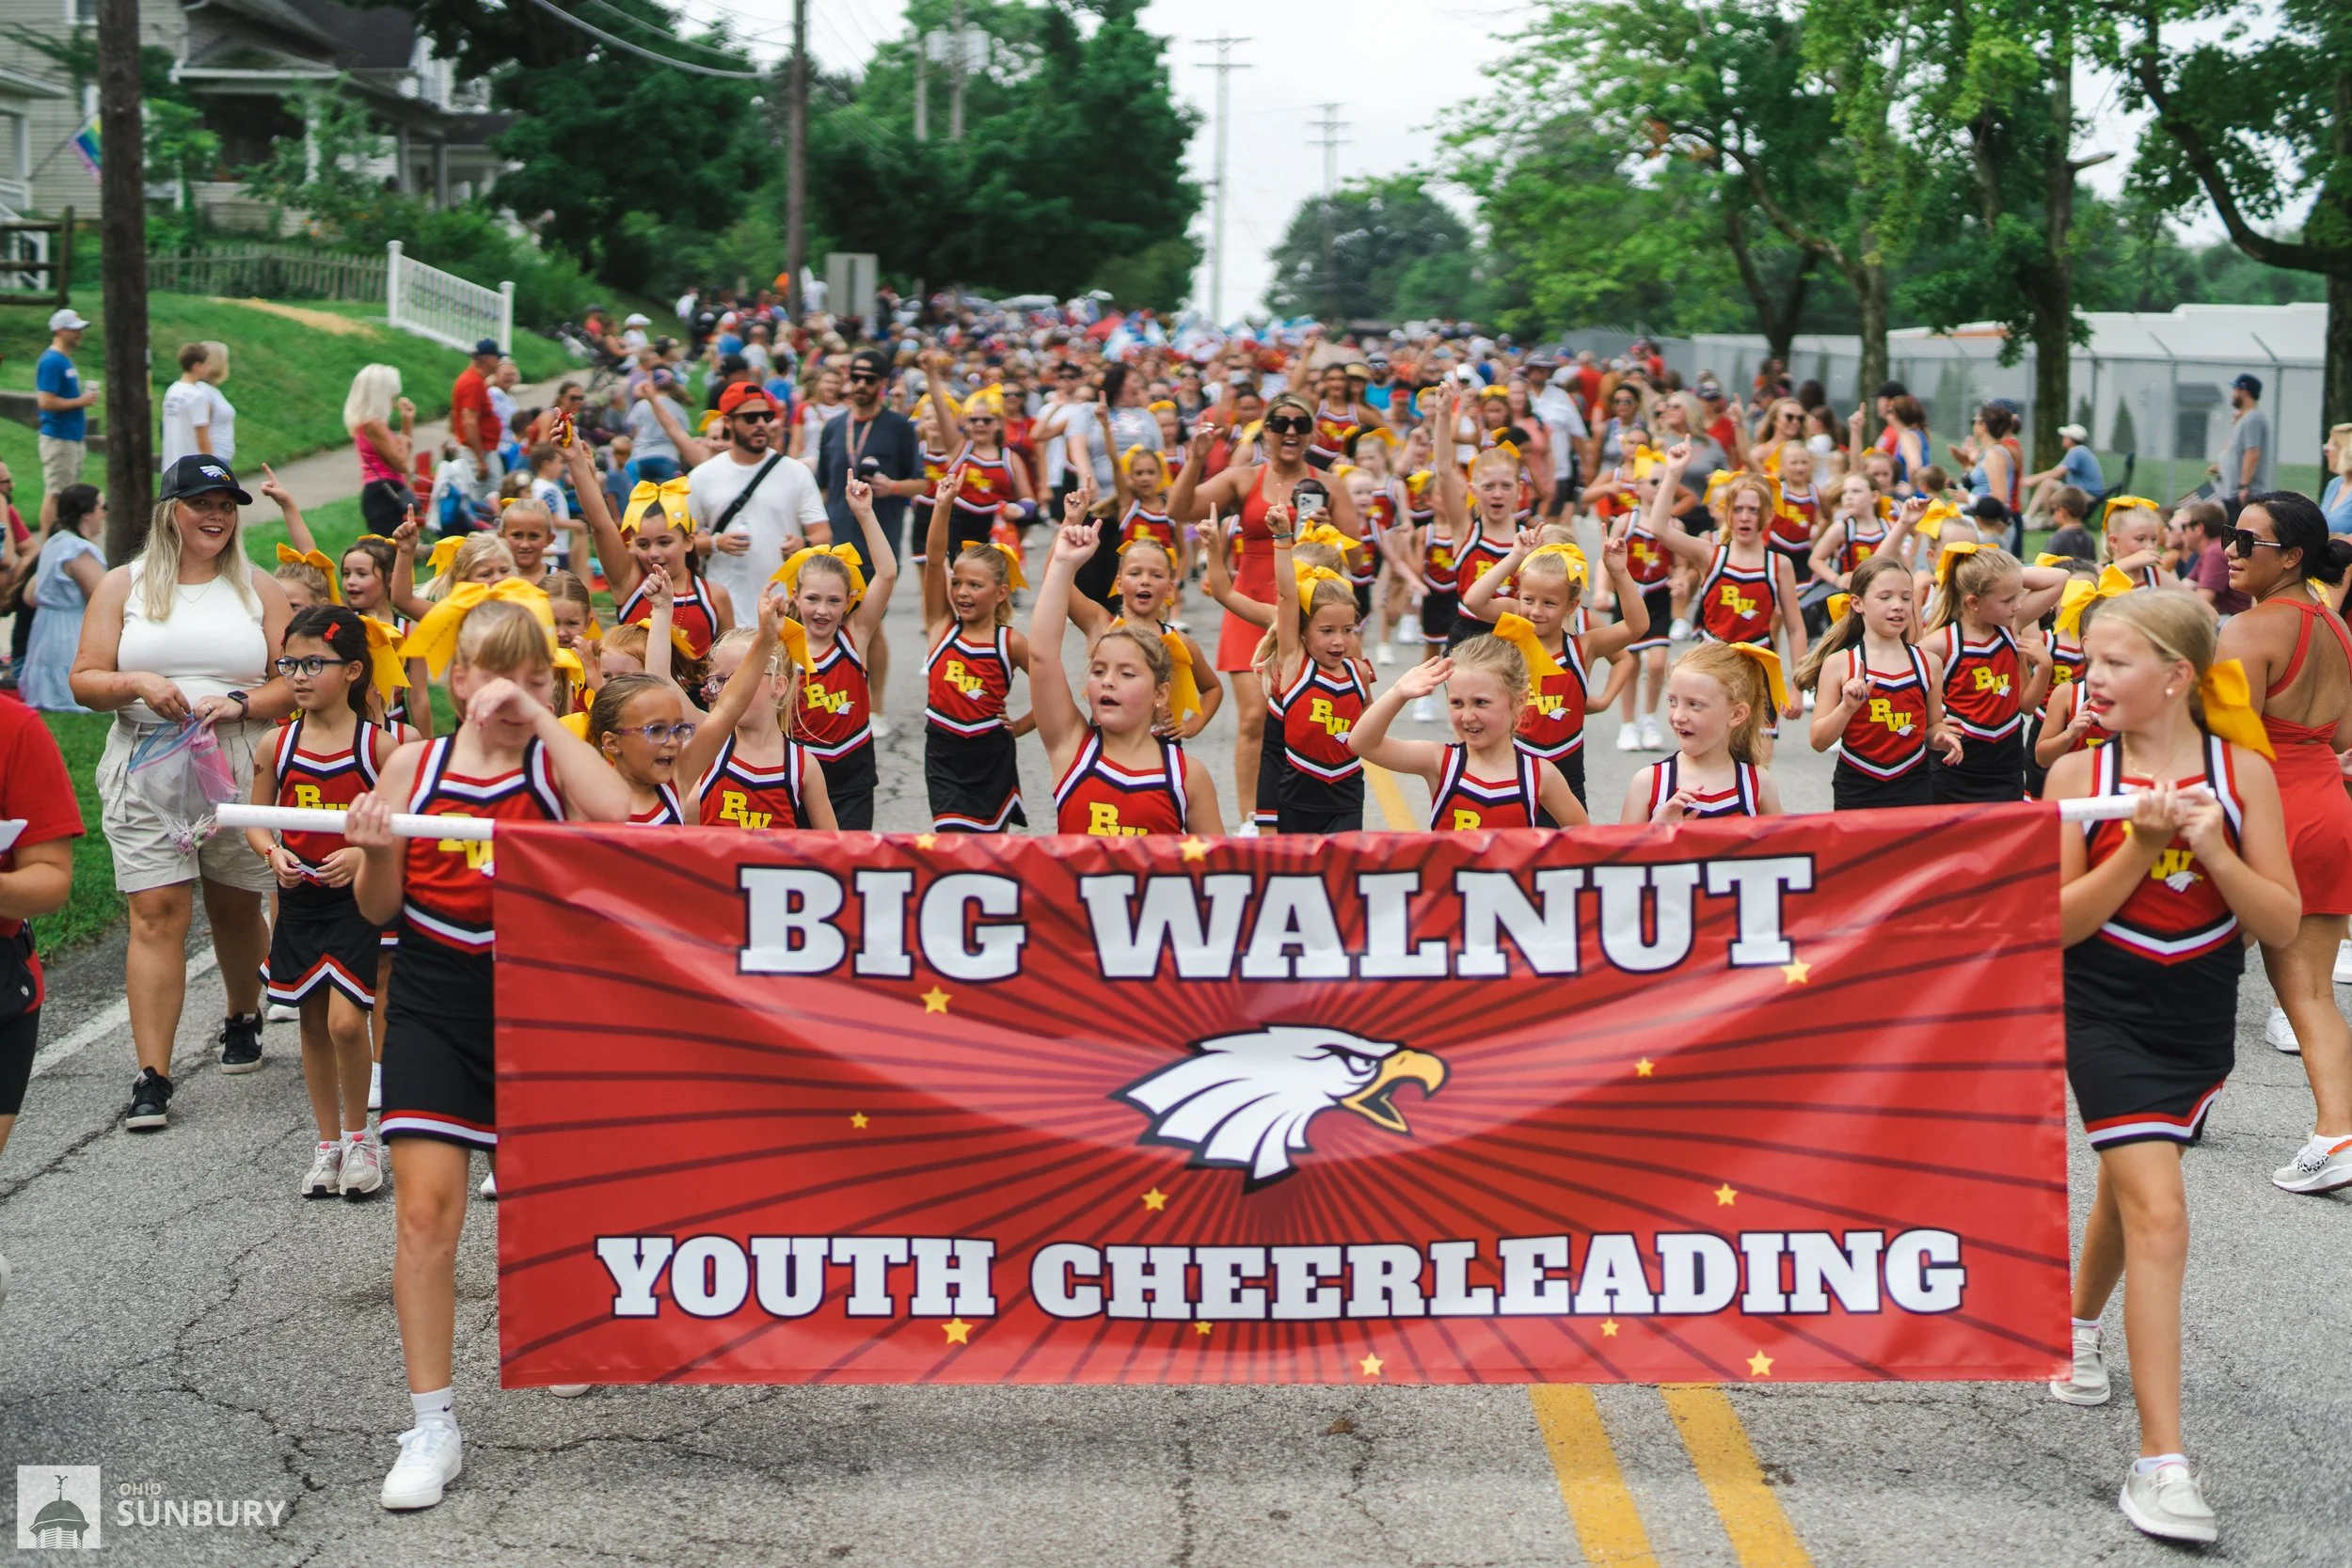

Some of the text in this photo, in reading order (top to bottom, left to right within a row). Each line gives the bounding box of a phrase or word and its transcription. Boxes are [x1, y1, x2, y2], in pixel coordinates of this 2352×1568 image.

[1720, 584, 1757, 615] BW
[943, 659, 984, 694] BW
[1971, 666, 2010, 695] BW
[2052, 664, 2073, 685] B
[803, 682, 848, 715] BW
[1868, 698, 1912, 733] BW
[1309, 697, 1351, 736] BW
[738, 854, 1816, 984] BIG WALNUT
[594, 1228, 1967, 1322] YOUTH CHEERLEADING
